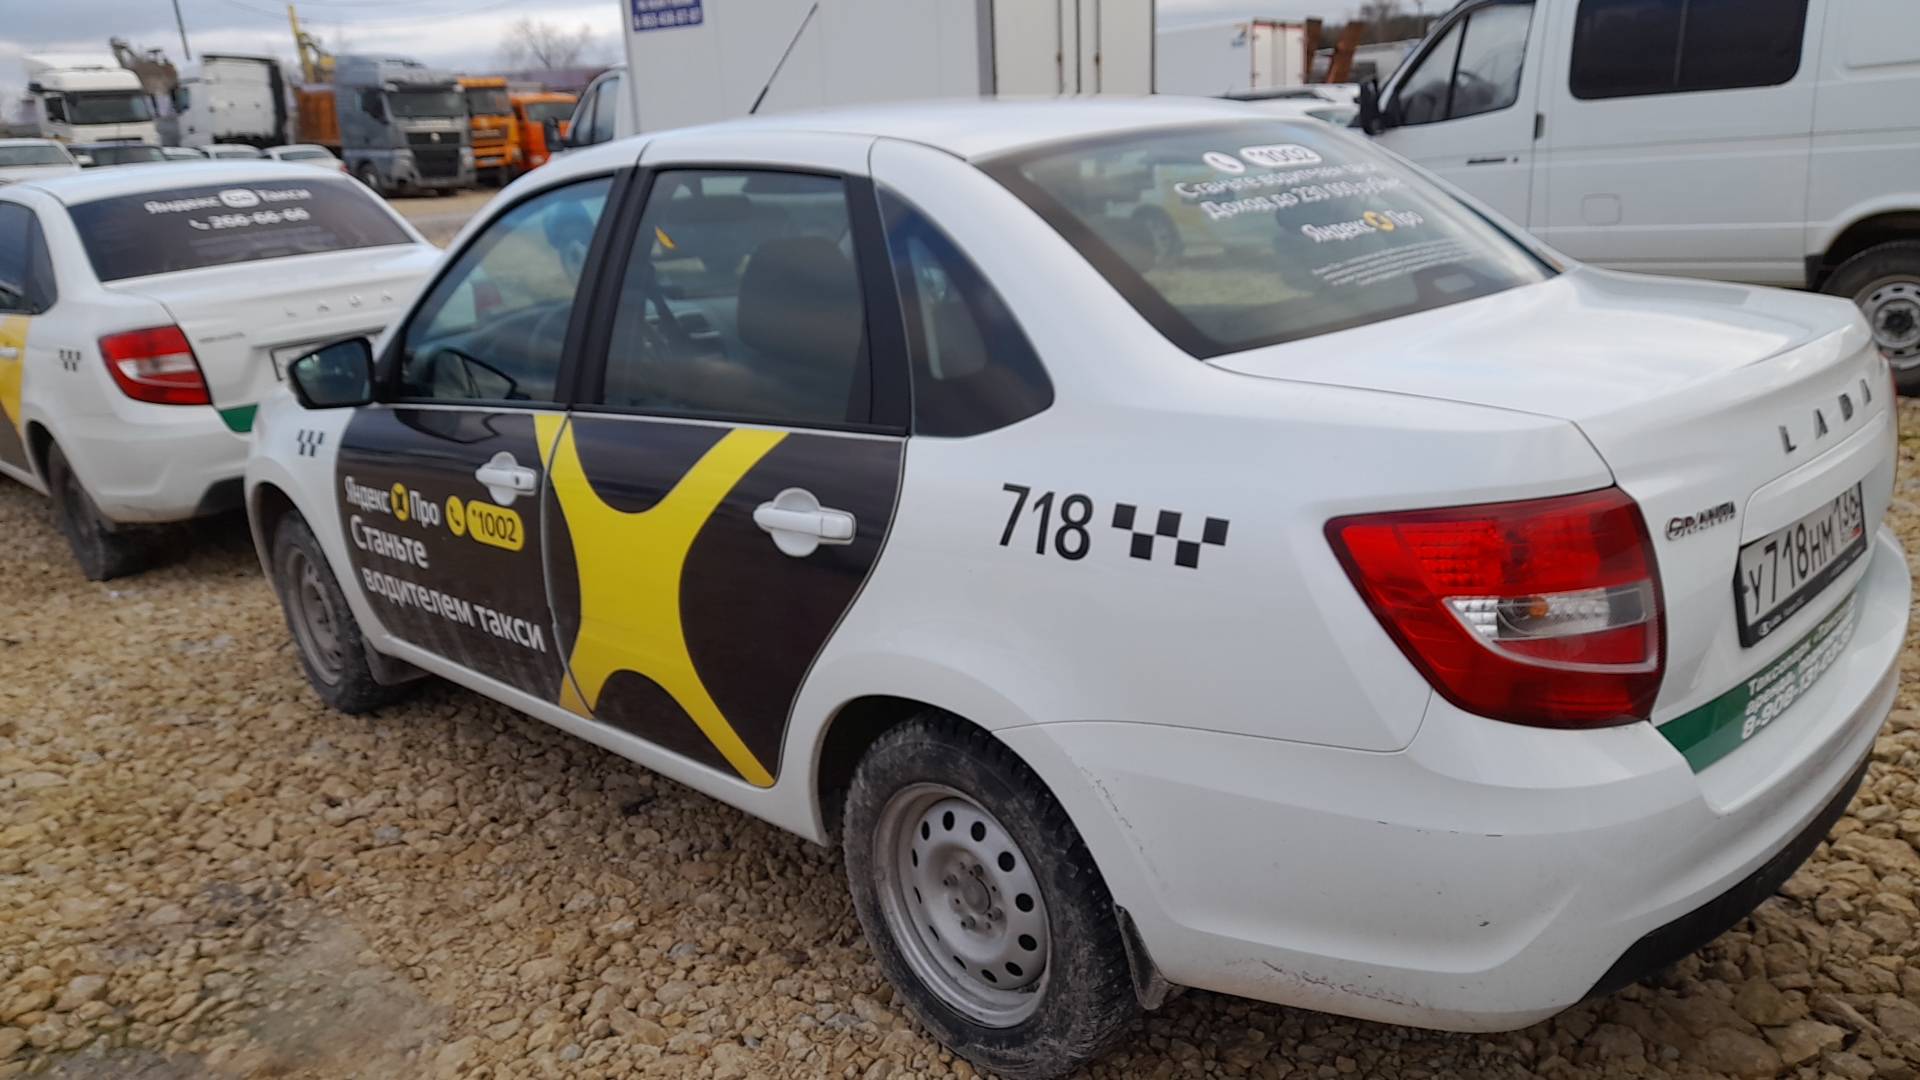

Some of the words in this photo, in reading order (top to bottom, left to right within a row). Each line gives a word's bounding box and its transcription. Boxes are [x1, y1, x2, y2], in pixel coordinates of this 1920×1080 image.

[1201, 193, 1280, 220] Доход
[1301, 218, 1377, 243] Яндекс
[1778, 378, 1872, 454] LADA
[345, 476, 392, 515] Яндекс
[410, 490, 440, 528] Про
[999, 482, 1094, 561] 718
[350, 515, 430, 570] Станьте
[361, 567, 475, 628] водителем
[474, 604, 547, 653] такси
